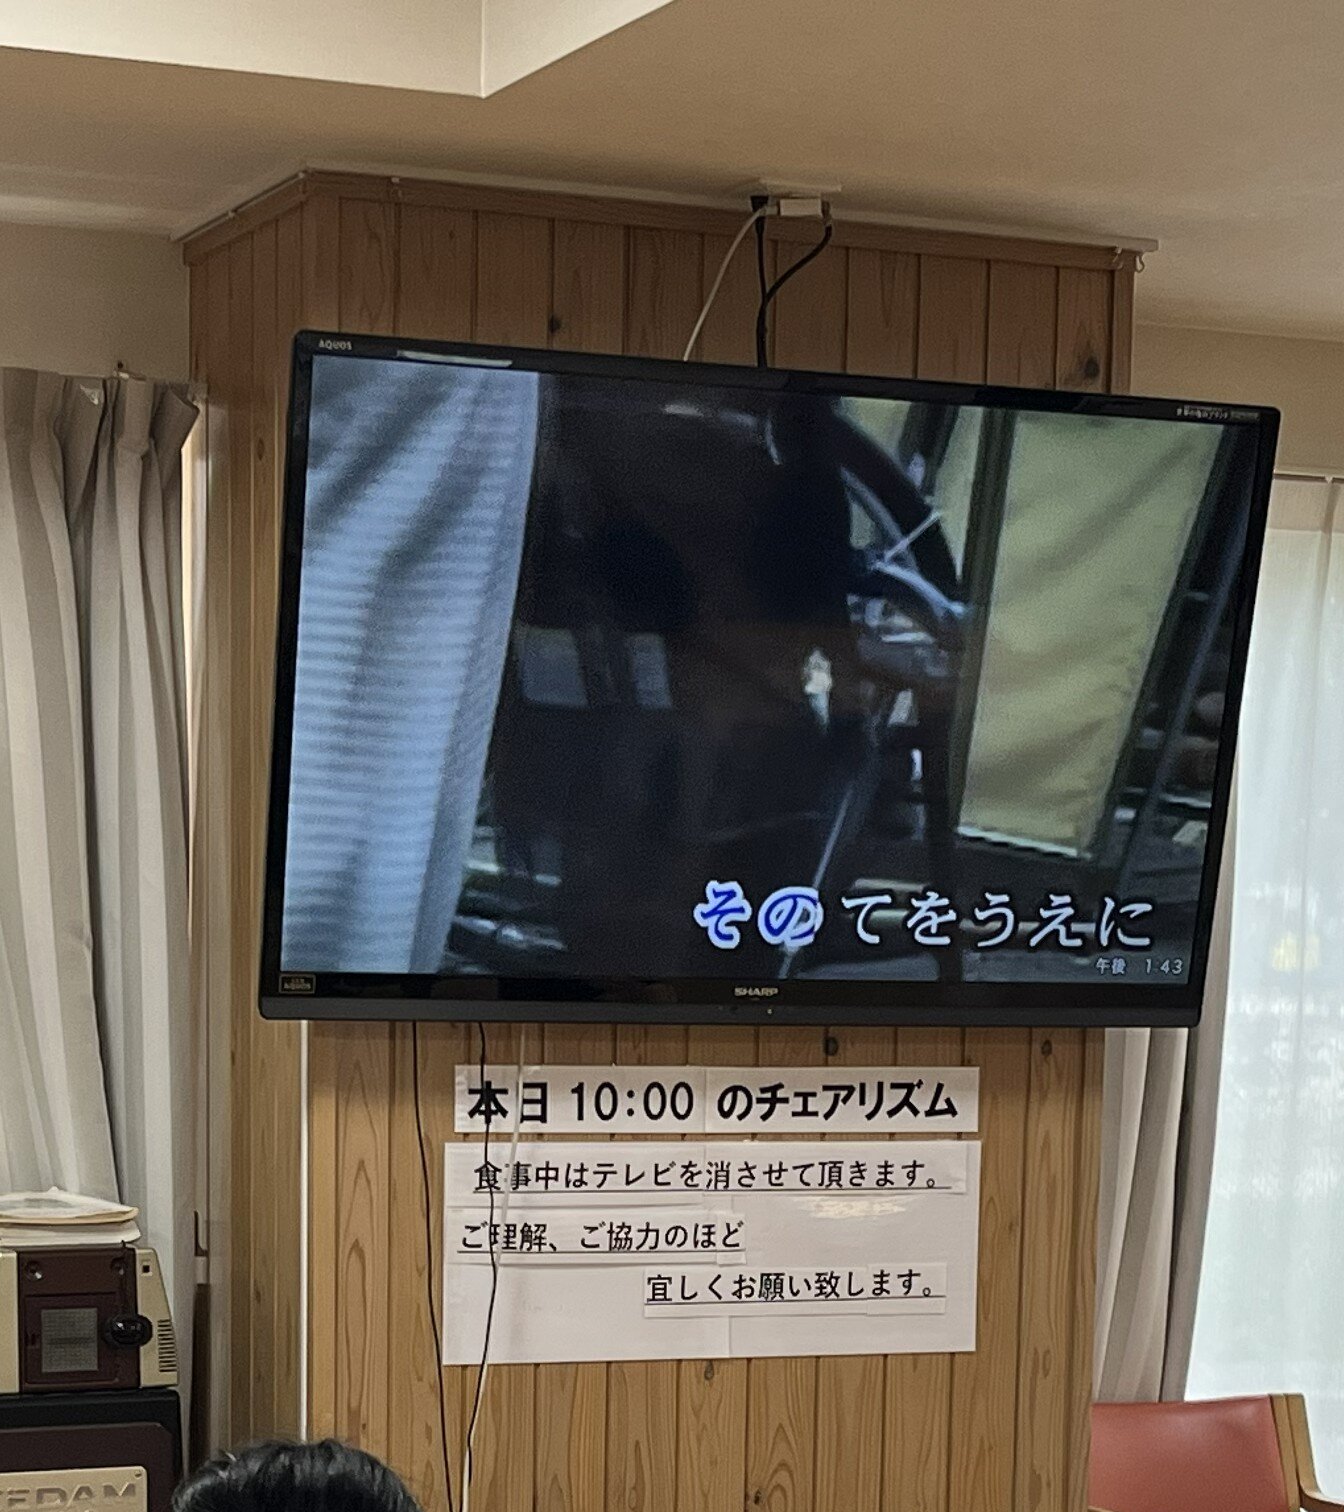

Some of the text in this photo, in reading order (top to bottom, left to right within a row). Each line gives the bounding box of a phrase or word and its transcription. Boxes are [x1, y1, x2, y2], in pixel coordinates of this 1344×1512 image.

[734, 986, 779, 997] SHARP
[467, 1079, 959, 1125] 本日 10:00 のチェアリズム
[473, 1159, 939, 1191] 食事中はテレビを消させて頂きます。
[460, 1219, 745, 1253] ご理解、ご協力のほど
[646, 1267, 934, 1303] 宜しくお願い致します。
